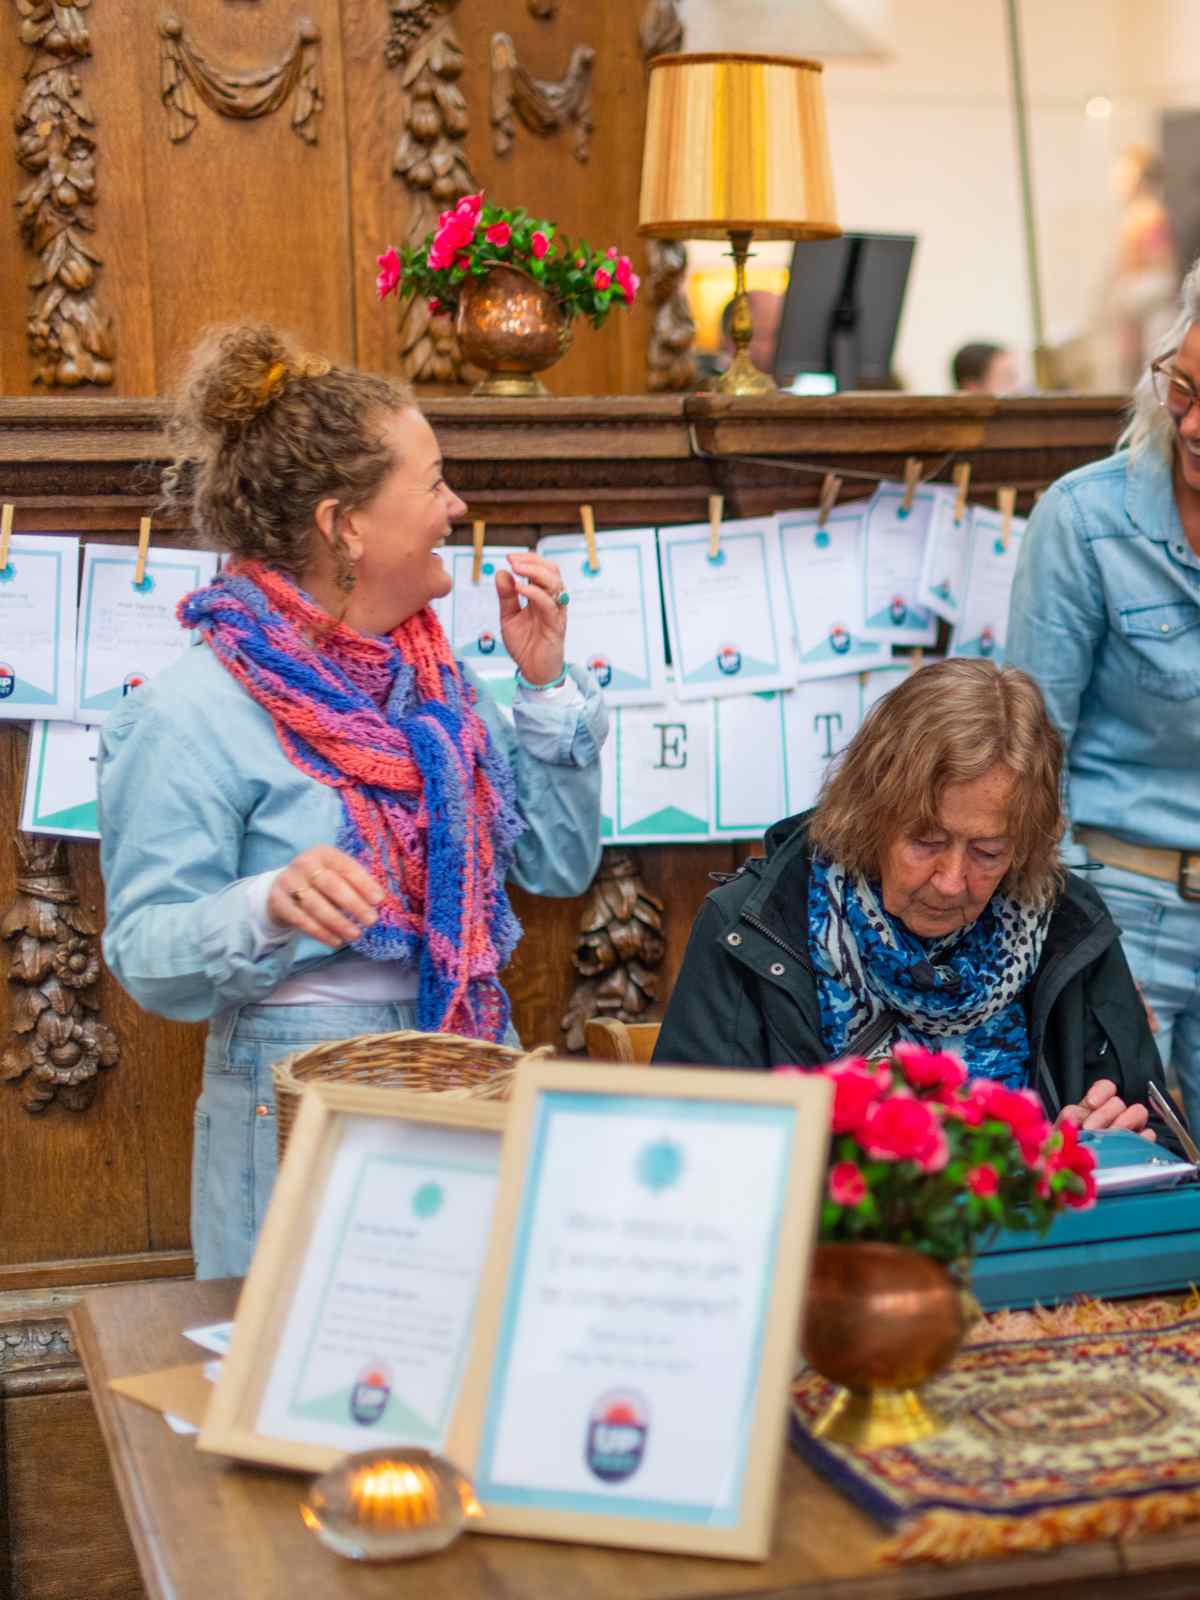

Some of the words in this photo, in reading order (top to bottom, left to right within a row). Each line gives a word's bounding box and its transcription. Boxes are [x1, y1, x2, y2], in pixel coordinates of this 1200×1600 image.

[653, 723, 687, 769] E
[814, 713, 843, 759] T
[594, 1425, 641, 1456] UP
